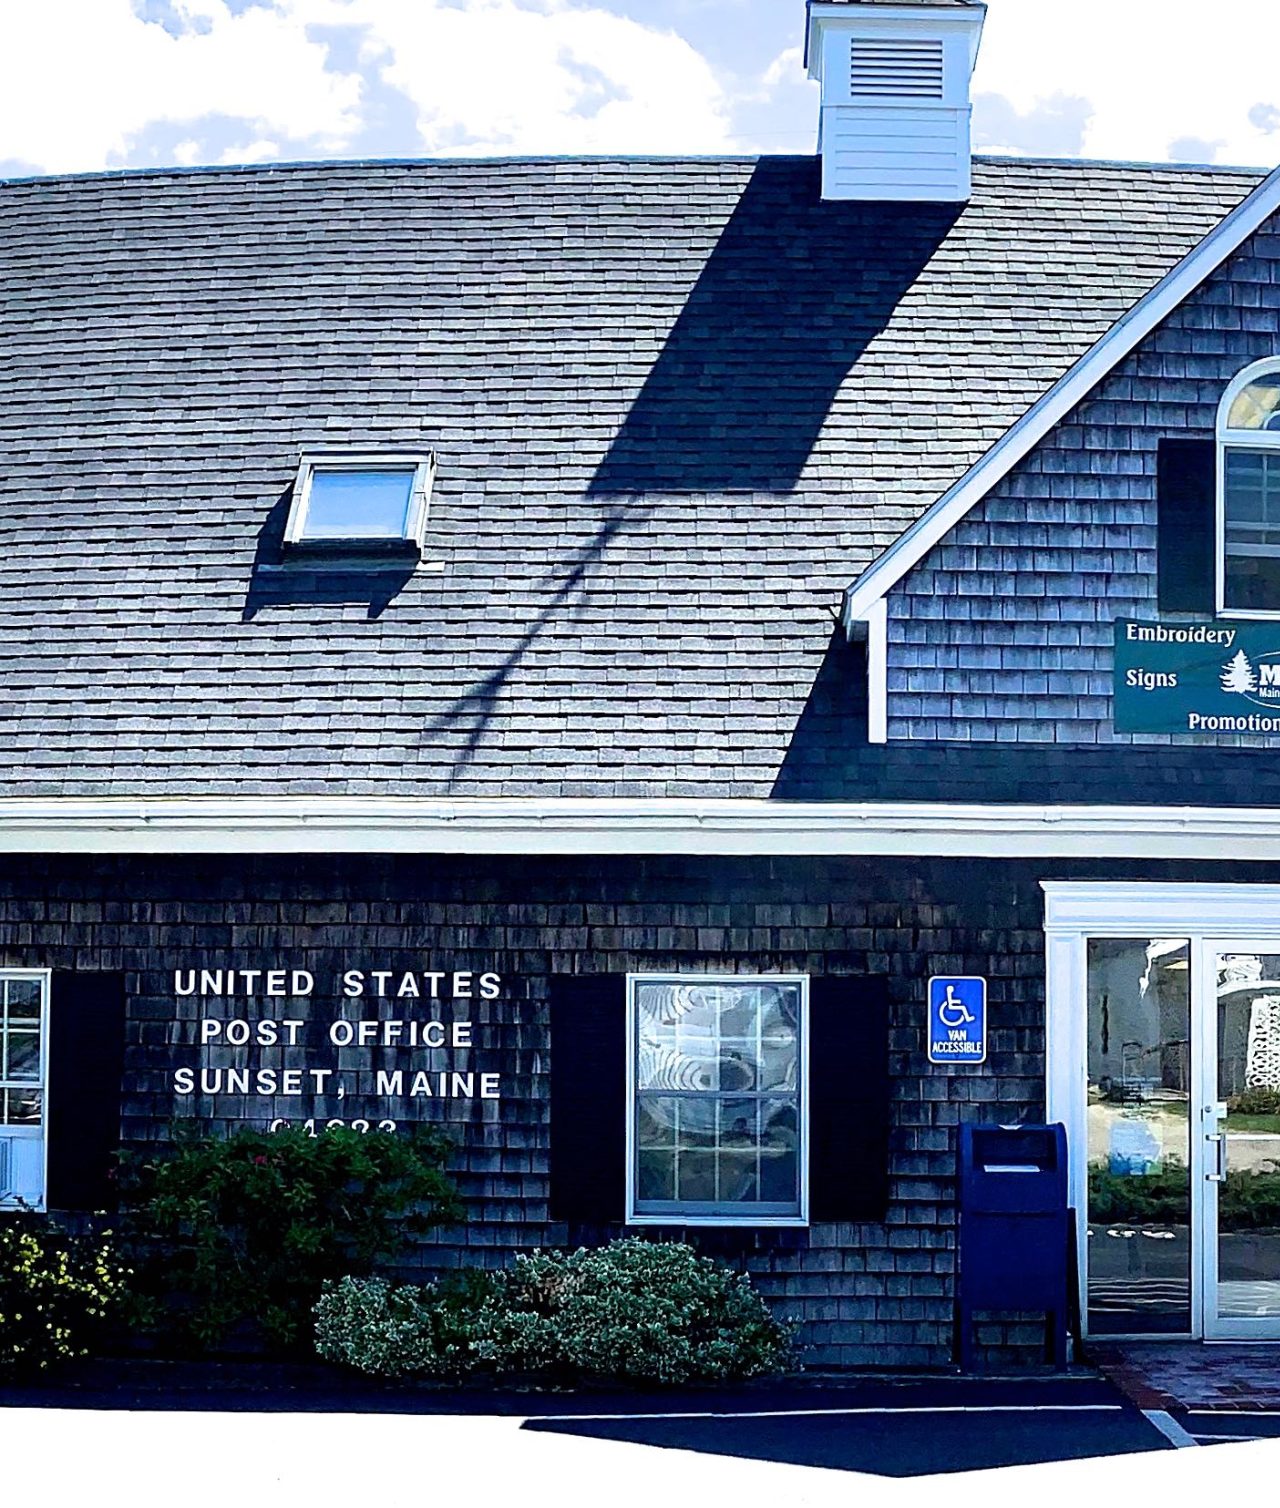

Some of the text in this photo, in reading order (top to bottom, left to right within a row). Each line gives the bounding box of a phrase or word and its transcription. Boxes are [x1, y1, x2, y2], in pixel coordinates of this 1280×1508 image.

[1126, 624, 1236, 647] Embroidery
[1126, 669, 1178, 691] Signs
[174, 970, 501, 999] UNITED STATES
[200, 1019, 473, 1048] POST OFFICE
[947, 1030, 967, 1041] VAN
[932, 1041, 982, 1053] ACCESSIBLE
[173, 1067, 501, 1100] SUNSET, MAINE
